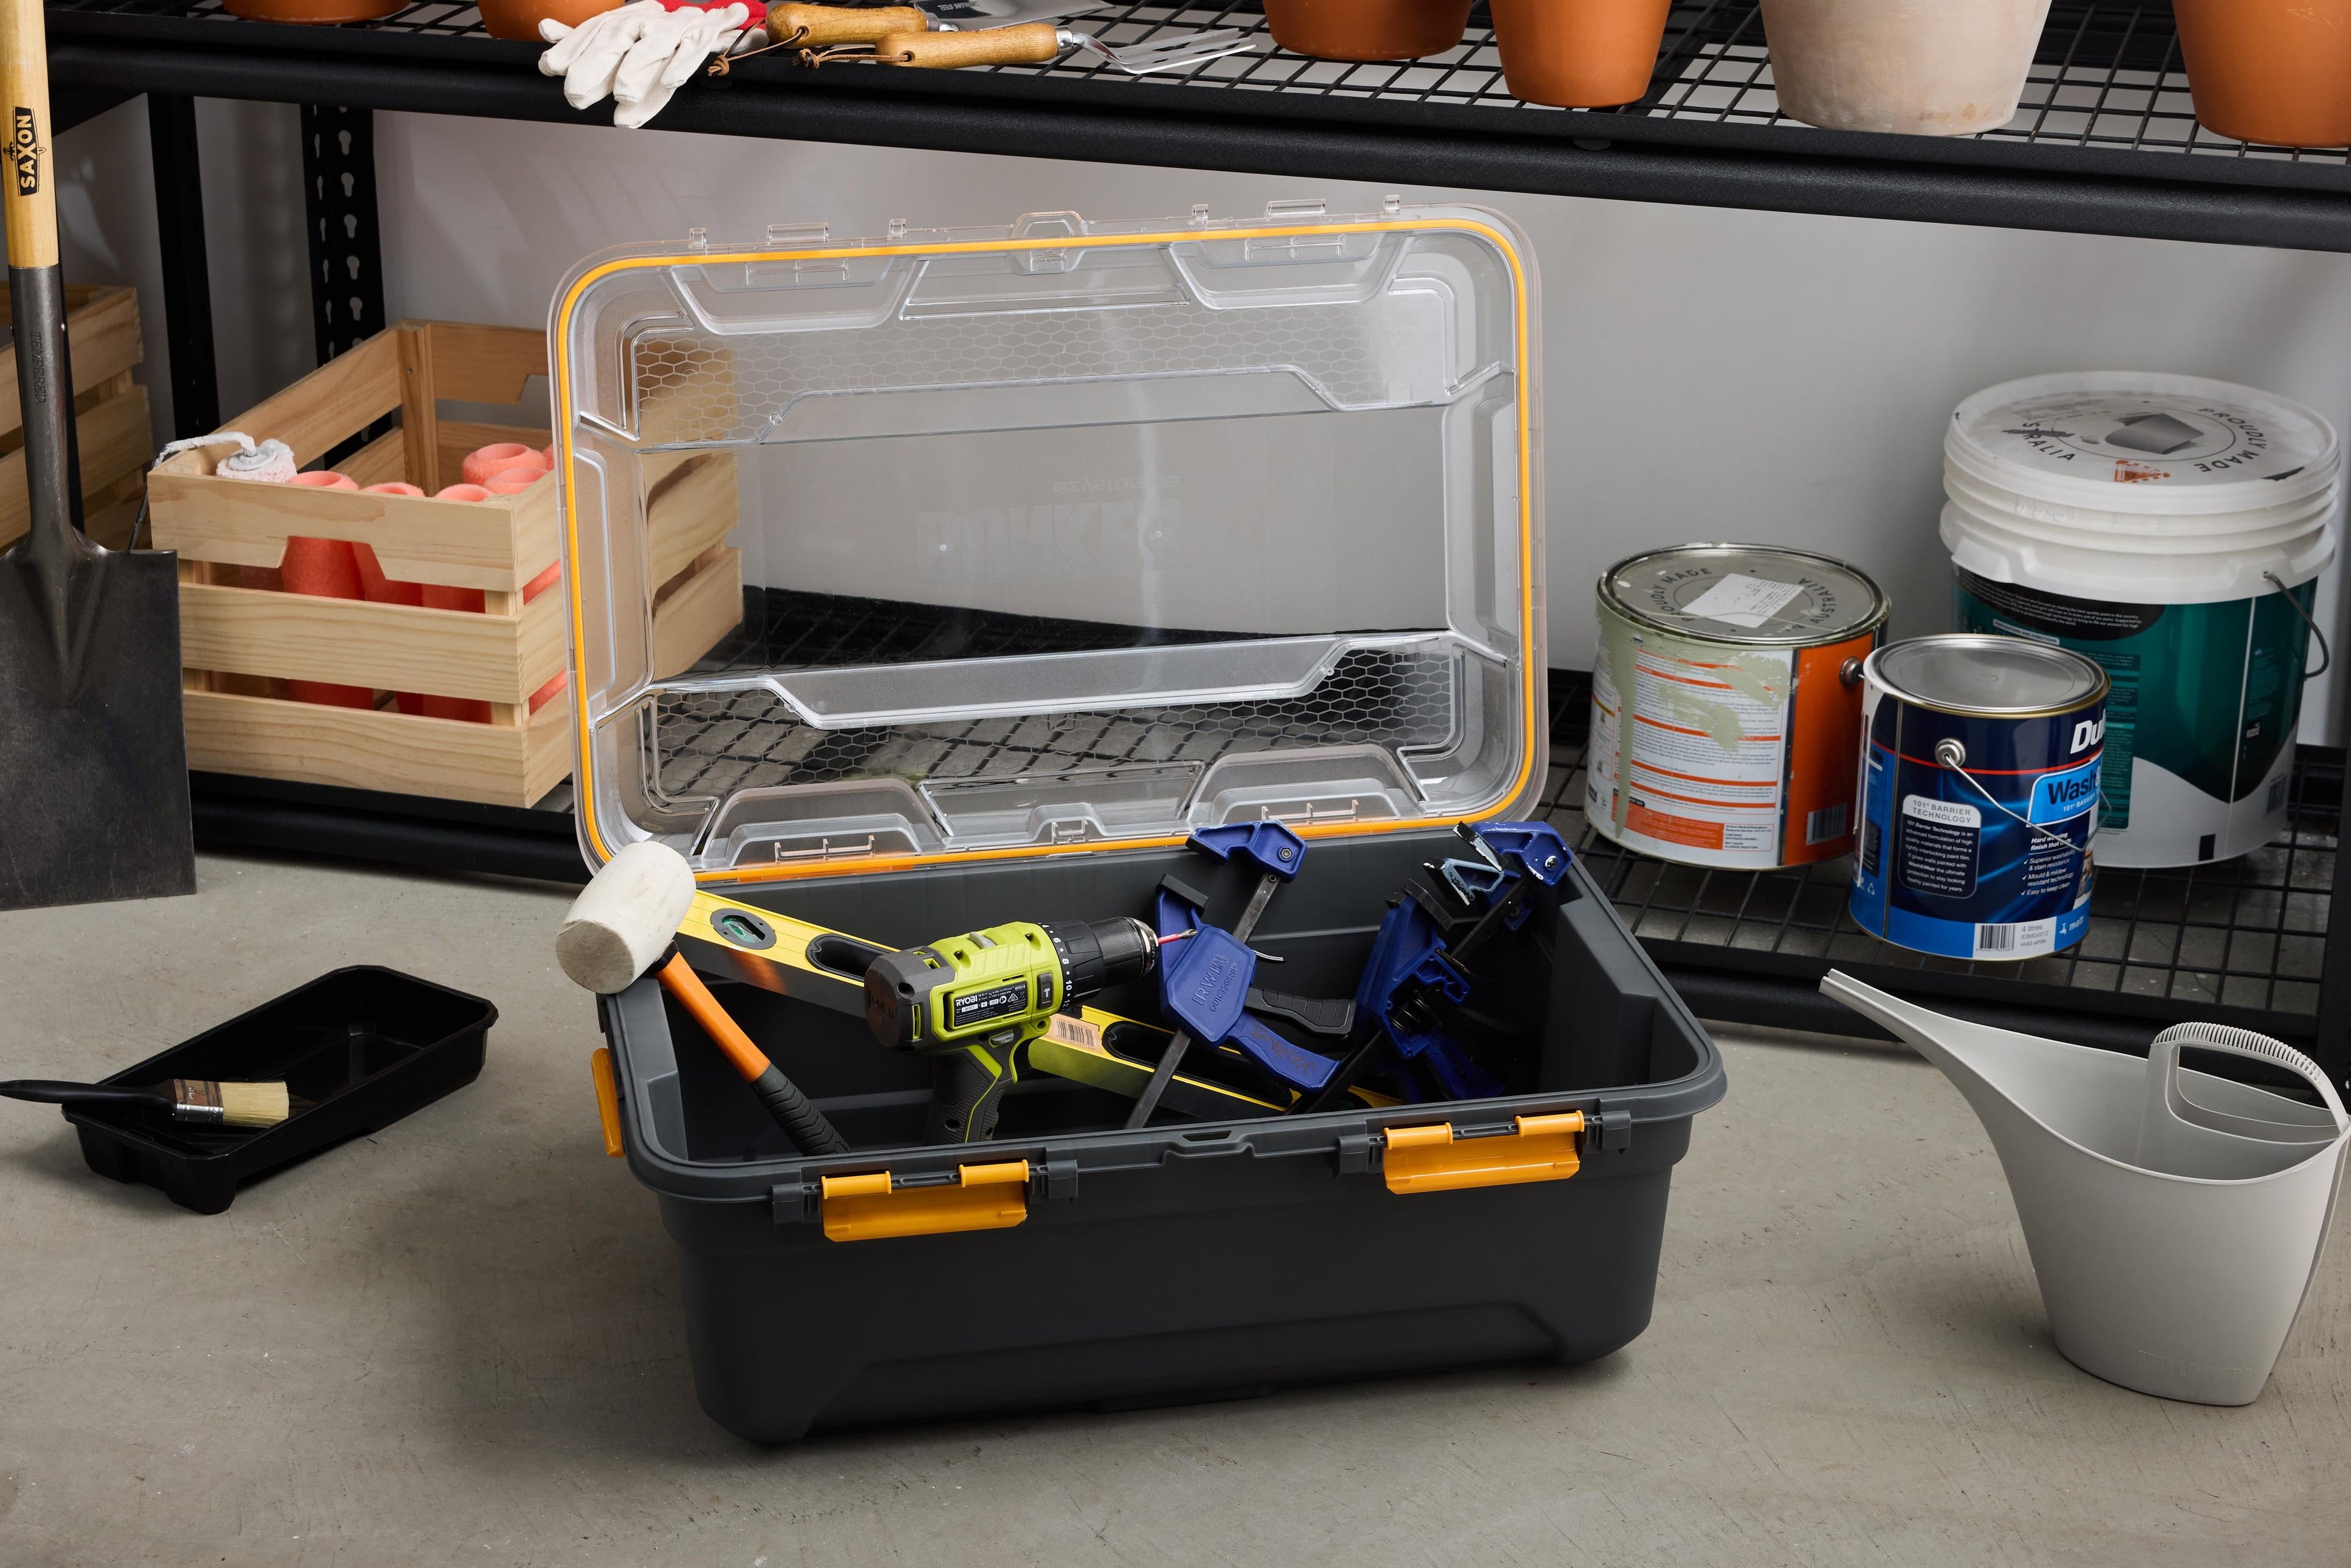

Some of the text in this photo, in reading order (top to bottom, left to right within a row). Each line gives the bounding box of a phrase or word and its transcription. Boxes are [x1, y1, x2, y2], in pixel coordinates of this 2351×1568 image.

[17, 115, 37, 188] SAXON
[30, 331, 47, 403] TEMPERED
[2194, 408, 2267, 472] PROUDLY MADE
[1651, 584, 1695, 622] PROUDLY
[1798, 577, 1837, 624] AUSTRALIA
[1913, 808, 1971, 823] TECHNOLOGY
[1932, 804, 1971, 816] BARRIER
[1906, 828, 1927, 837] advanced
[1928, 833, 1954, 842] formulation
[1933, 827, 1960, 836] Technology
[1919, 849, 1946, 858] interlocking
[2052, 849, 2075, 860] washability
[1908, 861, 1935, 871] Wash&Wear
[2047, 858, 2070, 868] resistance
[1907, 869, 1929, 878] protection
[2050, 872, 2074, 883] technology
[2069, 915, 2084, 931] matt
[1066, 980, 1072, 990] 10
[1191, 954, 1228, 1007] IRWIN
[955, 995, 978, 1007] RYOBI
